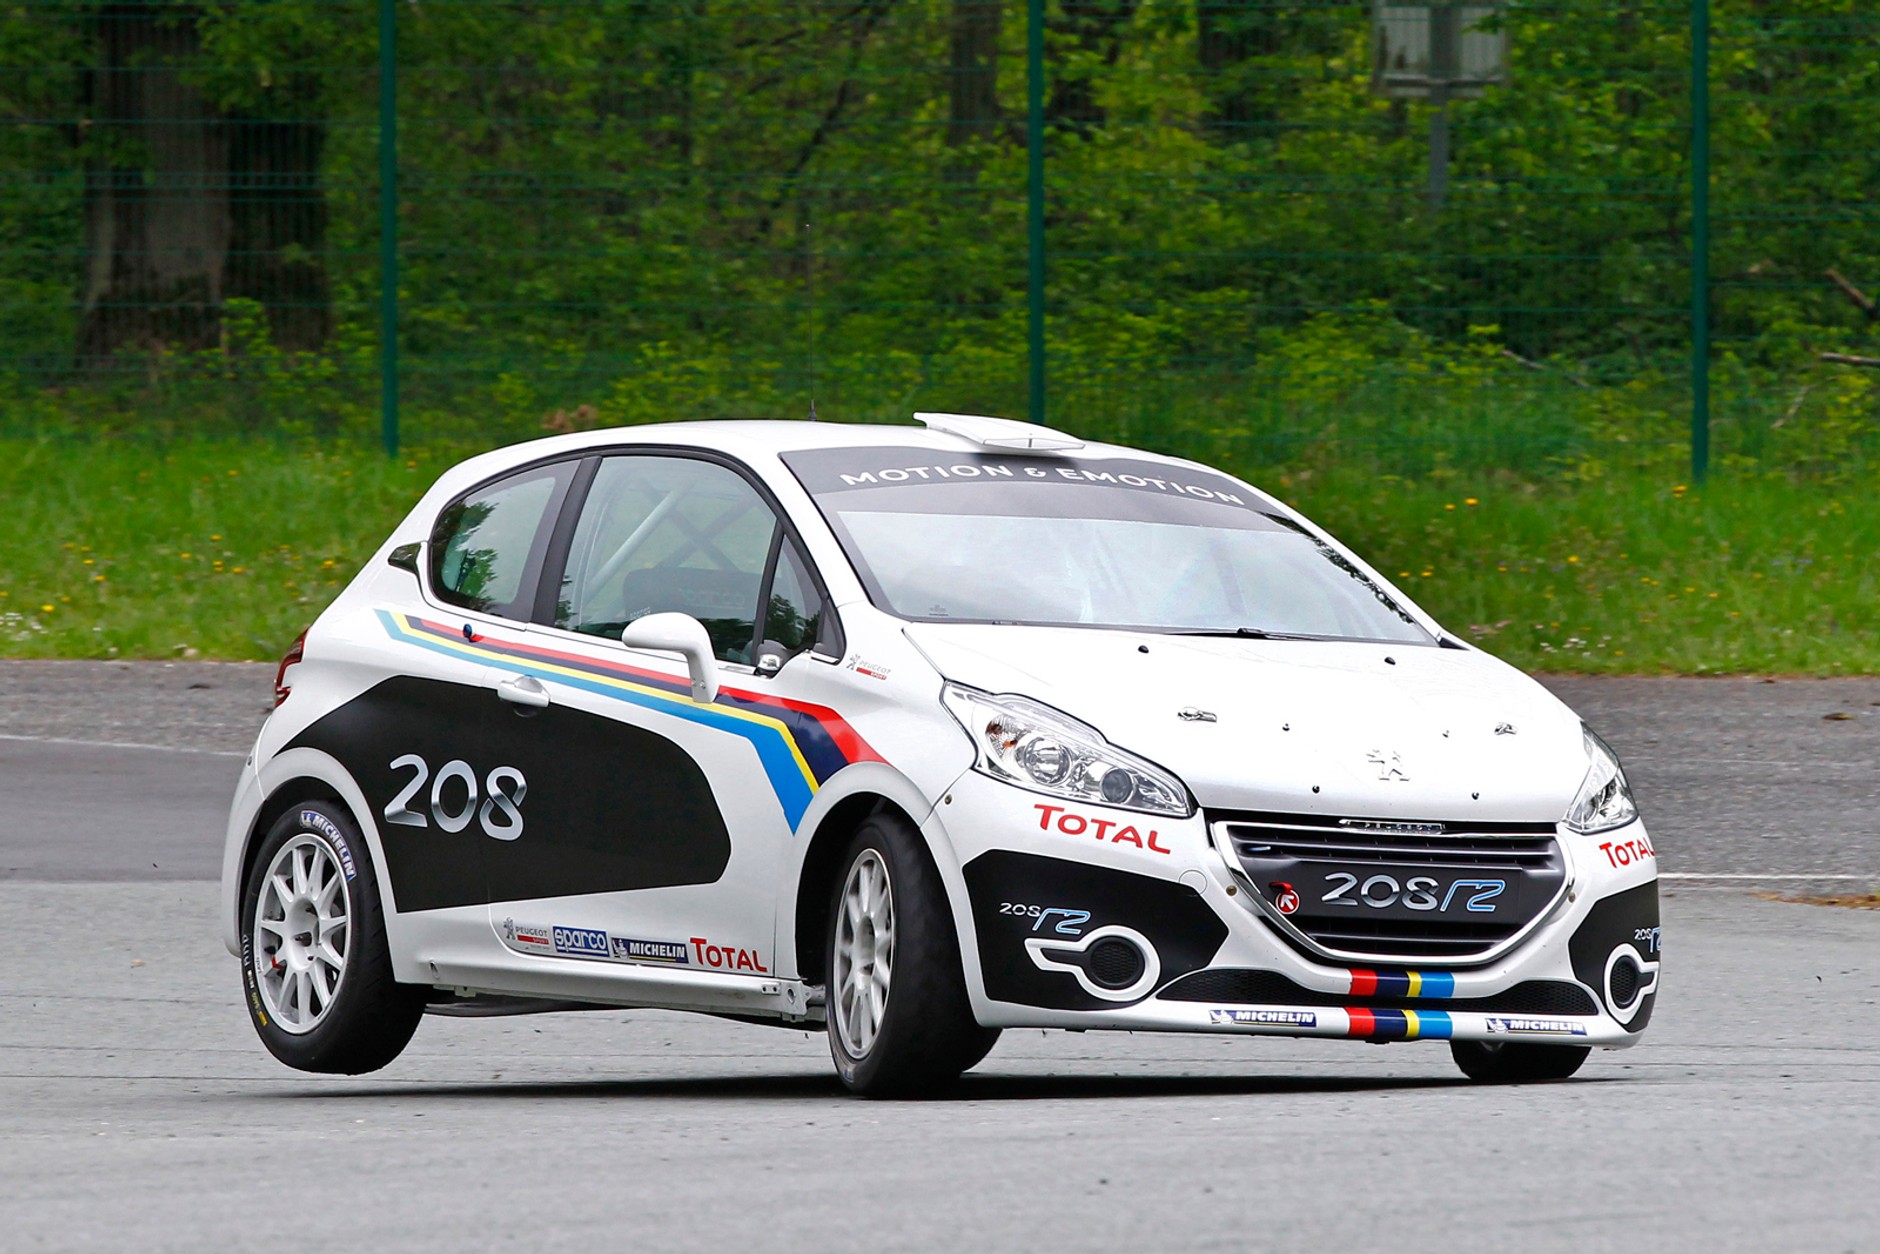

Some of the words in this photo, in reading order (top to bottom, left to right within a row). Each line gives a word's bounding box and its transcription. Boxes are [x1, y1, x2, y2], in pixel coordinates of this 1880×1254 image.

[839, 465, 1014, 486] MOTION
[1024, 466, 1046, 478] &
[1056, 467, 1245, 506] EMOTION
[858, 660, 892, 675] PEUGEOT
[384, 753, 528, 841] 208
[1034, 804, 1171, 855] TOTAL
[312, 814, 355, 877] MICHELIN
[1598, 837, 1656, 869] TOTAL
[515, 926, 548, 937] PEUGEOT
[554, 928, 607, 951] sparco
[629, 943, 686, 959] MICHELIN
[690, 937, 767, 973] TOTAL
[1235, 1011, 1314, 1023] MICHELIN
[1509, 1020, 1585, 1031] MICHELIN
